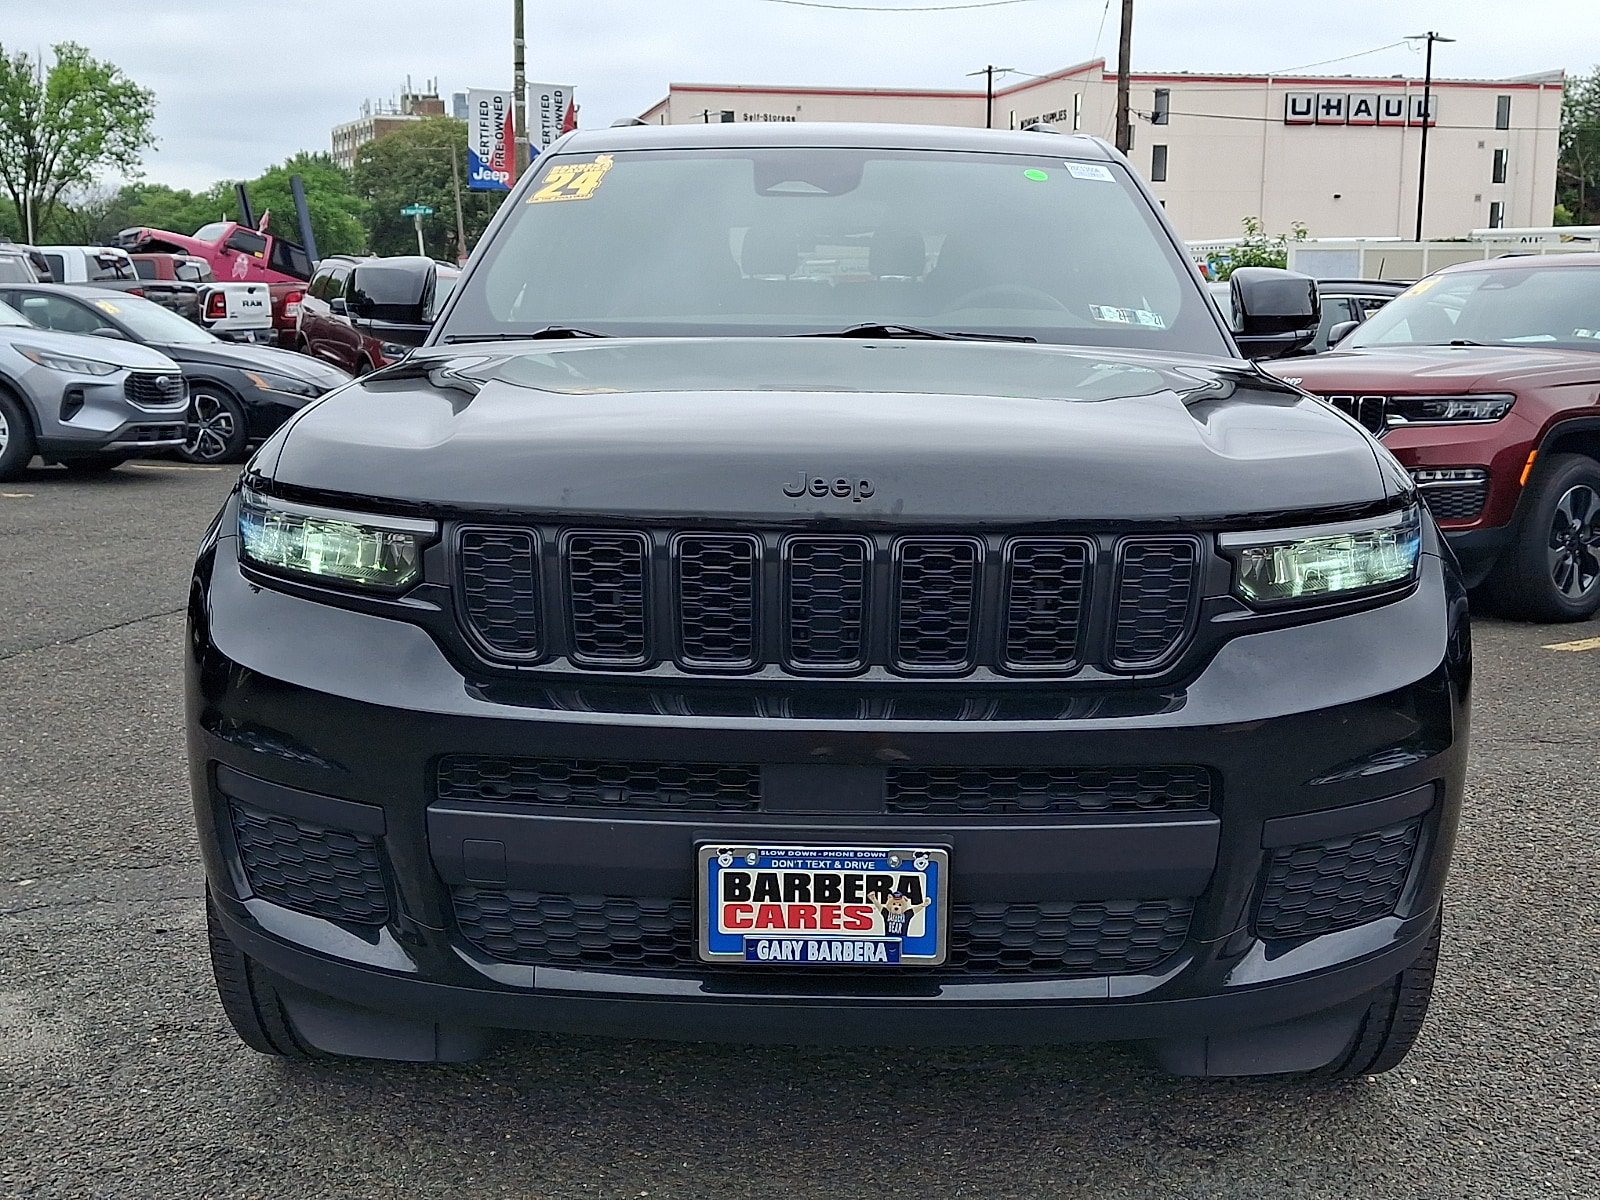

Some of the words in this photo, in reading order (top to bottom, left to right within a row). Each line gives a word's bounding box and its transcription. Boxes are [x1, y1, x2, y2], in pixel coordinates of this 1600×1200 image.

[743, 112, 796, 123] Self-Storage
[1042, 109, 1067, 123] SUPPLIES
[480, 100, 489, 164] CERTIFIED
[472, 166, 509, 183] Jeep
[532, 171, 604, 198] 24
[783, 470, 876, 503] Jeep
[771, 859, 802, 868] DON'T
[804, 860, 832, 869] TEXT
[834, 861, 843, 869] &
[844, 861, 876, 870] DRIVE
[723, 871, 924, 906] BARBERA
[723, 903, 874, 931] CARES
[888, 921, 902, 934] BEAR
[757, 939, 804, 961] GARY
[807, 940, 888, 962] BARBERA
